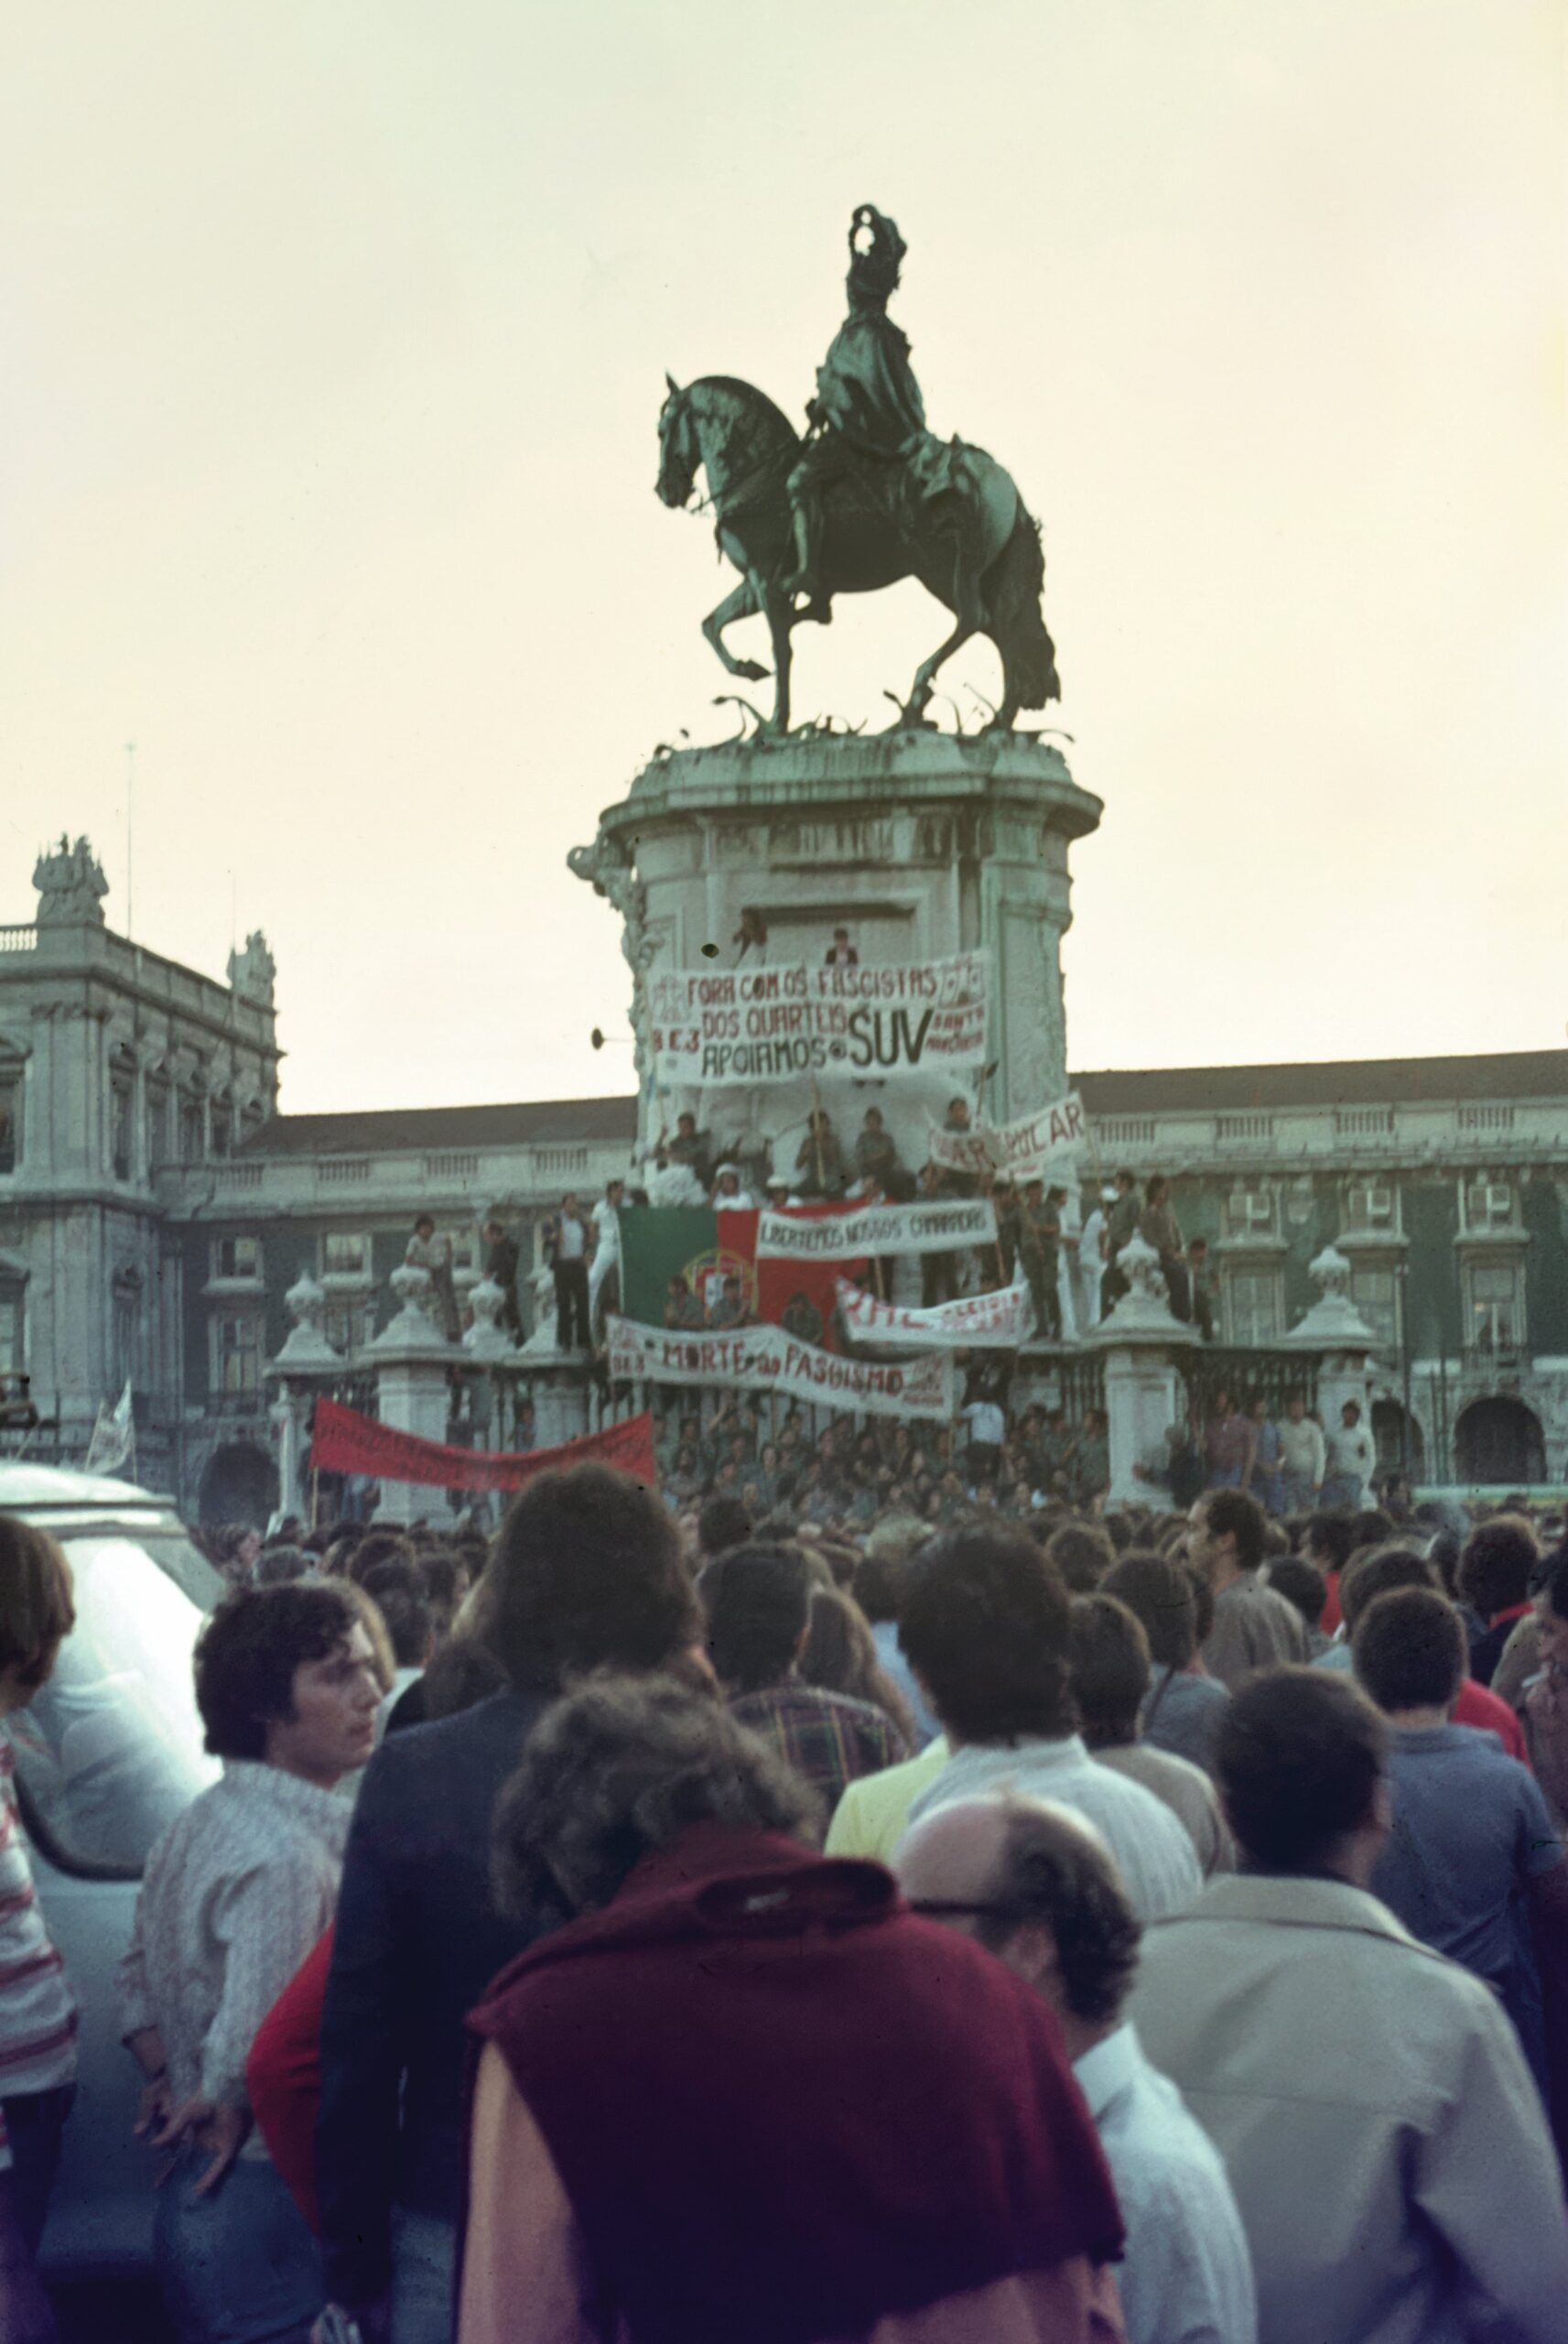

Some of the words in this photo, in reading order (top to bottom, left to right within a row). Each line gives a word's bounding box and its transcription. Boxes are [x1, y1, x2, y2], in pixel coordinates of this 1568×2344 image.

[688, 975, 736, 1006] FORA
[740, 971, 779, 1002] COM
[784, 967, 807, 997] OS
[818, 966, 937, 998] FASCISTAS
[702, 1010, 740, 1039] DOS
[746, 1002, 848, 1038] QUARTEIS
[702, 1037, 827, 1079] APOIAMOS
[849, 1008, 935, 1068] SUV
[662, 1340, 746, 1376] MORTE
